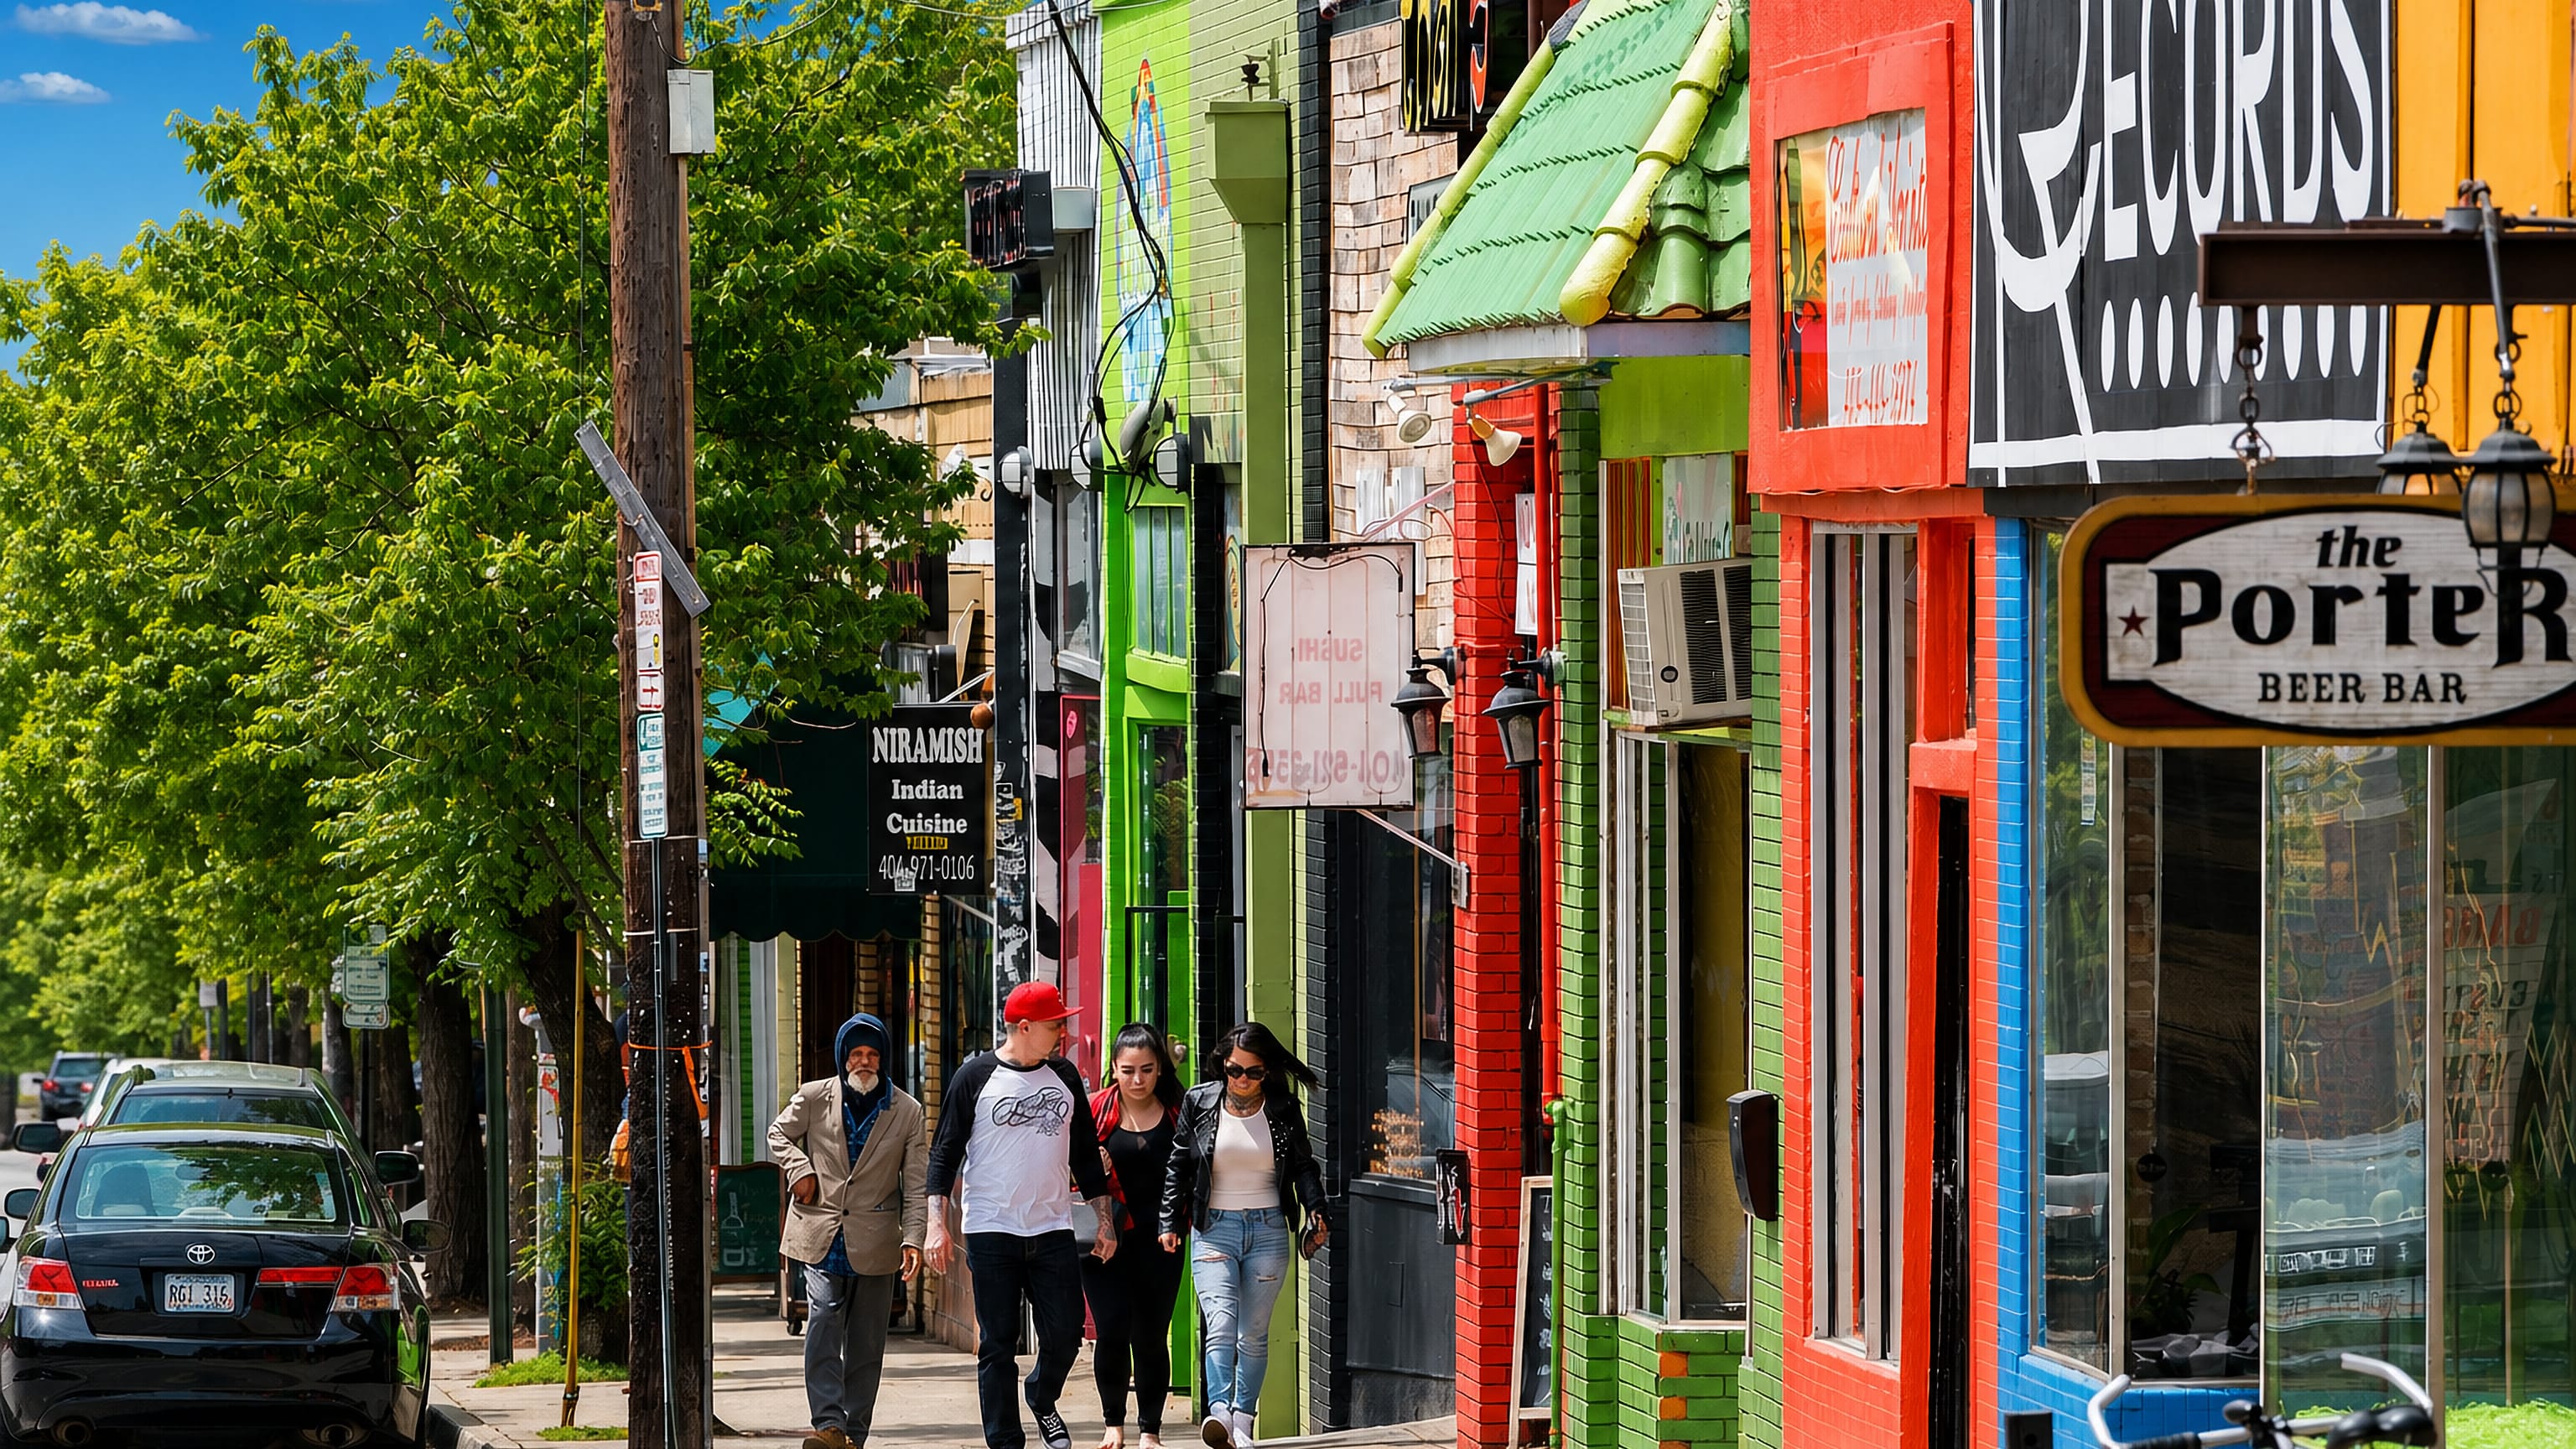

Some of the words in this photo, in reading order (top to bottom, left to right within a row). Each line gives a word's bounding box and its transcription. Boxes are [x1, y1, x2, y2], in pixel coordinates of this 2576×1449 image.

[2316, 525, 2402, 569] the
[2258, 673, 2366, 704] BEER
[2382, 673, 2468, 704] BAR
[872, 726, 984, 764] NIRAMISH
[891, 779, 964, 800] Indian
[886, 813, 968, 834] Cuisine
